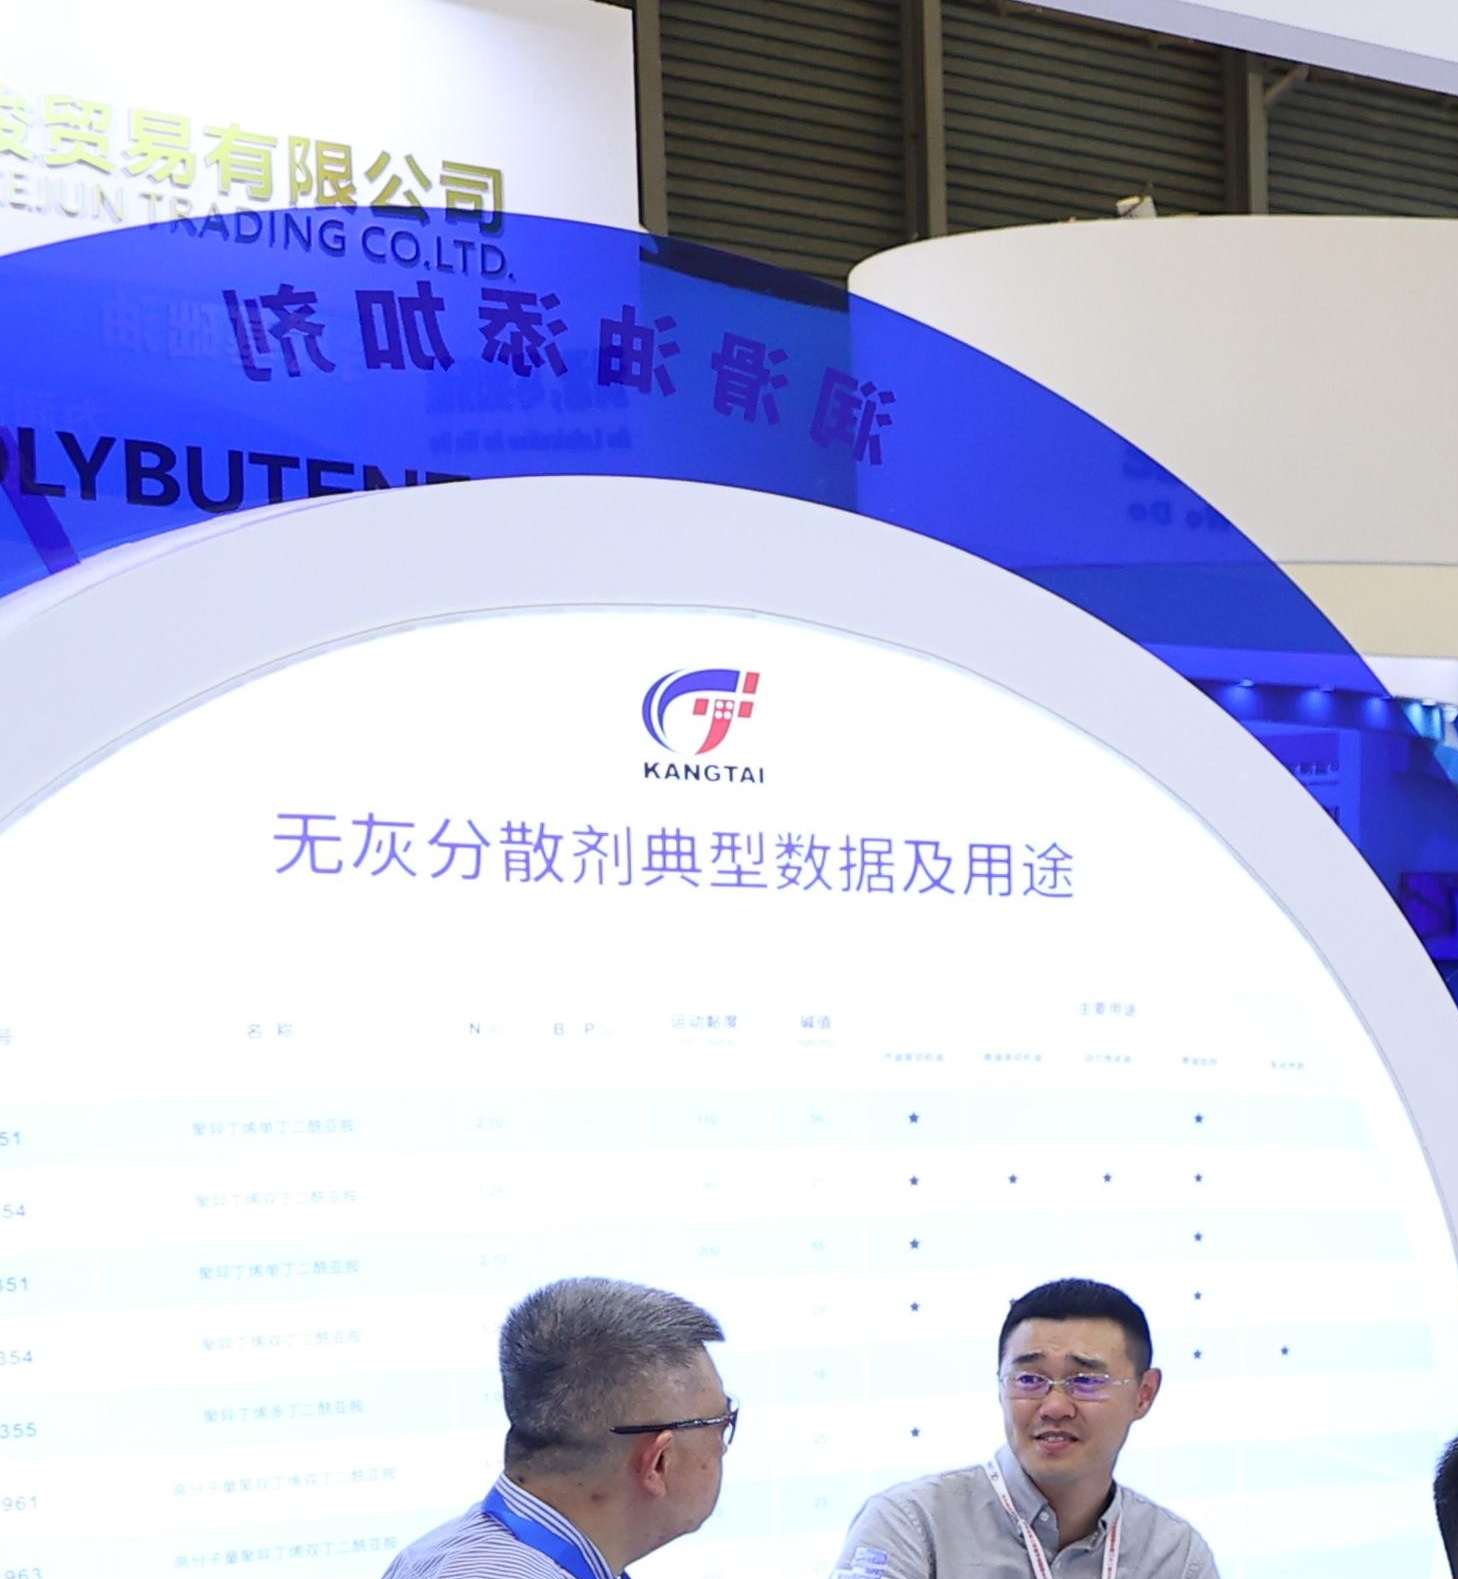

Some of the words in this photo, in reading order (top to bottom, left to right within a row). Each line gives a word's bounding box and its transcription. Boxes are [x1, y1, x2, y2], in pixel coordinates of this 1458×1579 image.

[0, 170, 125, 221] EJUN
[139, 191, 347, 256] TRADING
[0, 427, 471, 513] LYBUTE
[644, 761, 764, 784] KANGTAI
[273, 811, 1074, 898] 无灰分散剂典型数据及用途
[468, 1023, 481, 1036] N
[553, 1023, 564, 1036] B
[584, 1023, 595, 1036] P
